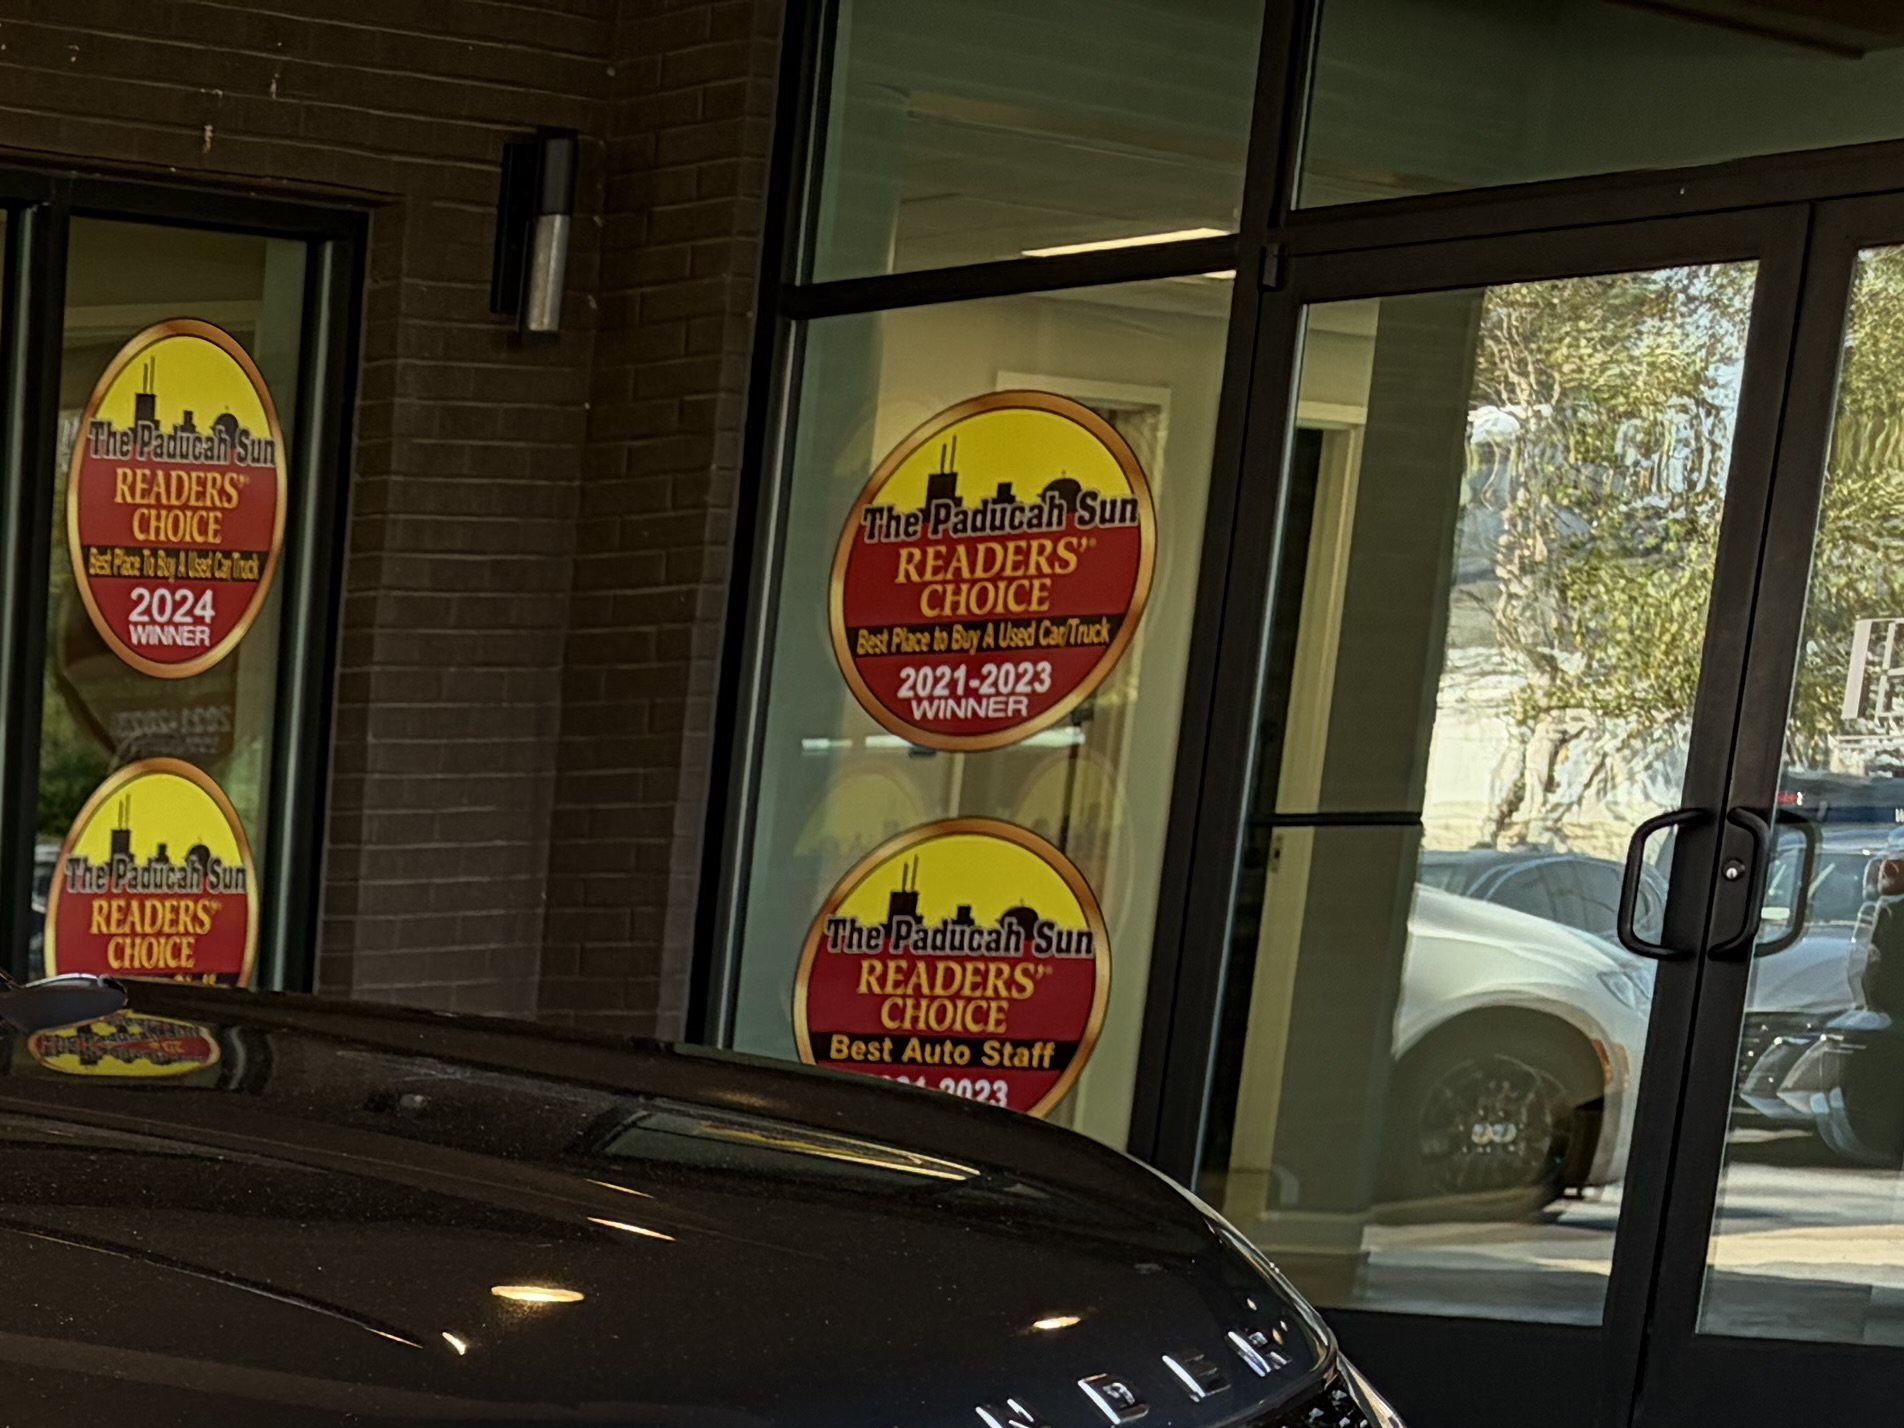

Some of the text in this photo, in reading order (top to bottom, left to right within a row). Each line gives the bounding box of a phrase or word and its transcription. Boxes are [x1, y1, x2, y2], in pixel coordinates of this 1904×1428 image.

[88, 417, 133, 460] The
[136, 420, 230, 466] Paducah
[234, 427, 275, 467] Sun
[132, 508, 223, 544] CHOICE
[861, 489, 1140, 544] The Paducah Sun
[89, 547, 112, 576] Best
[113, 548, 141, 577] Place
[157, 550, 177, 583] Buy
[178, 550, 187, 578] A
[188, 550, 212, 579] Used
[128, 587, 215, 624] 2024
[920, 578, 1052, 618] CHOICE
[129, 624, 211, 647] WINNER
[857, 628, 889, 655] Best
[891, 626, 931, 653] Place
[951, 624, 981, 655] Buy
[982, 622, 994, 649] A
[998, 620, 1036, 648] Used
[897, 661, 1052, 699] 2021-2023
[911, 696, 1029, 721] WINNER
[65, 853, 247, 894] The Paducah Sun
[107, 936, 196, 969] CHOICE
[824, 914, 1095, 959] The Paducah Sun
[881, 997, 1010, 1034] CHOICE
[829, 1033, 1056, 1069] Best Auto Staff
